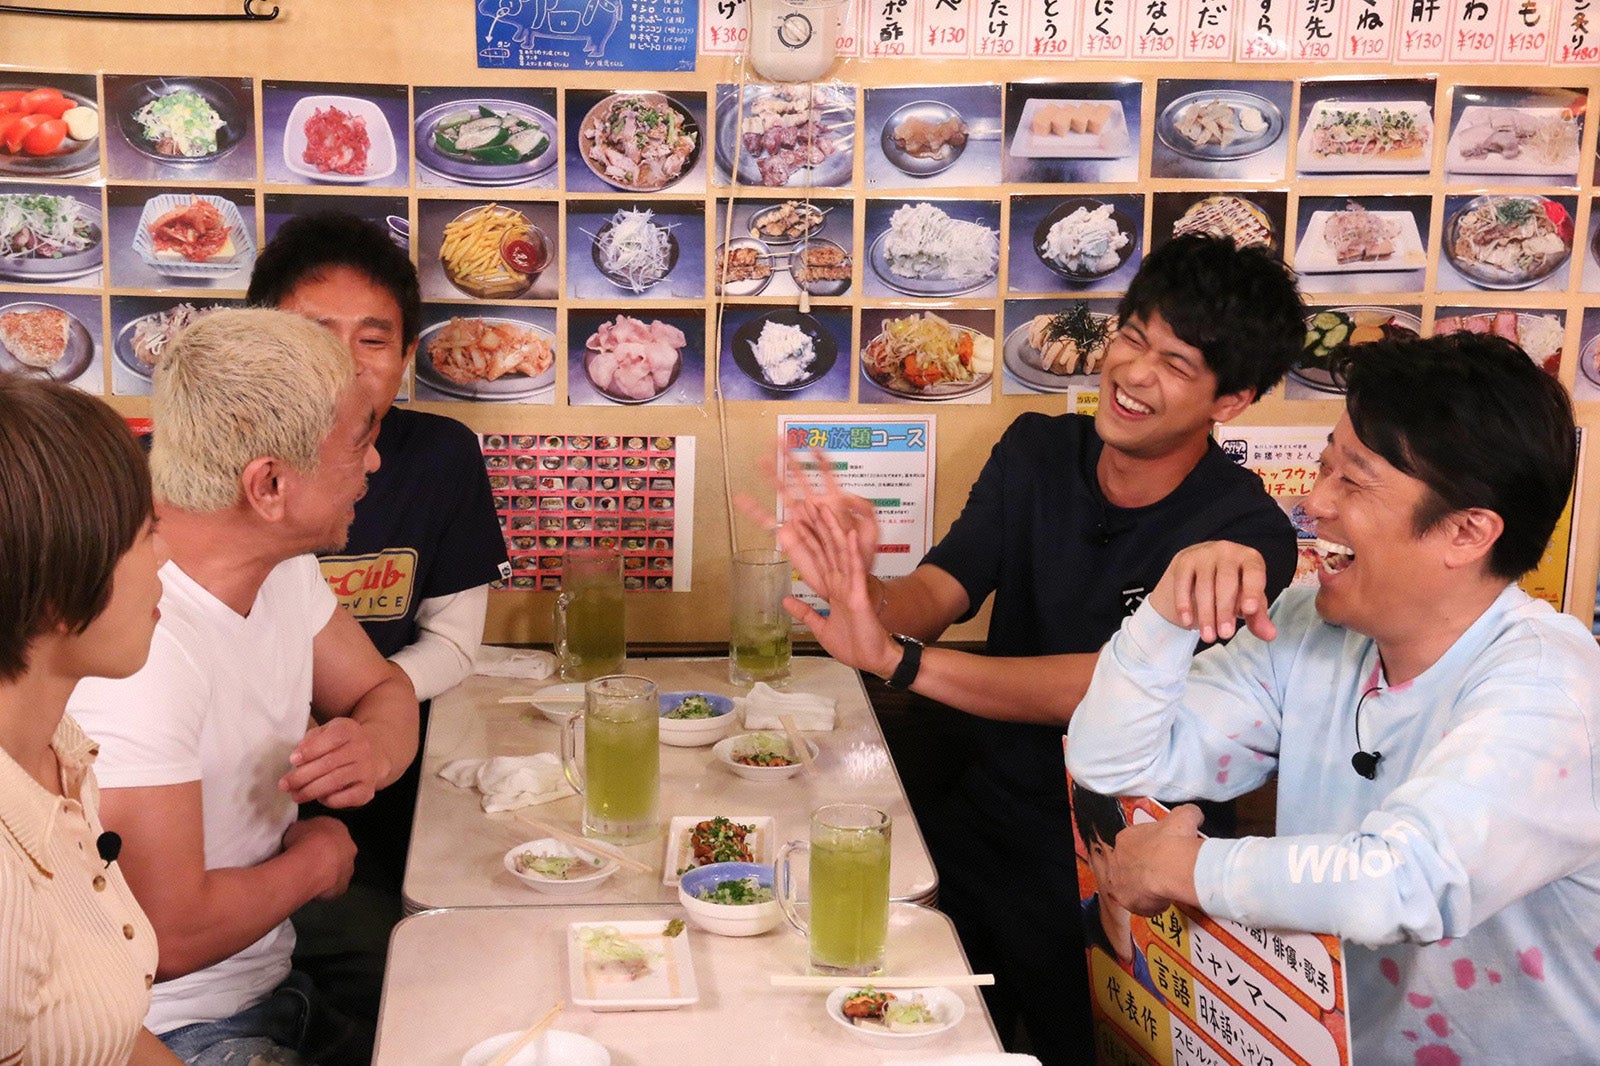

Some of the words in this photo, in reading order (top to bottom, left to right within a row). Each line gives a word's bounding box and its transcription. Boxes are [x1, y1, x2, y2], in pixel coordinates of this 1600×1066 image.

[1094, 0, 1114, 35] にく
[1145, 0, 1169, 36] なん
[1197, 0, 1228, 29] だ
[711, 27, 748, 46] ¥380
[929, 25, 966, 46] ¥130
[981, 36, 1014, 54] ¥130
[1034, 37, 1067, 55] ¥130
[1087, 34, 1122, 53] ¥130
[1139, 35, 1174, 54] ¥130
[1189, 30, 1226, 53] ¥130
[1350, 35, 1384, 56] ¥130
[1405, 30, 1442, 52] ¥130
[1457, 29, 1495, 51] ¥130
[1507, 33, 1545, 52] ¥130
[1298, 40, 1331, 57] ¥130
[787, 427, 926, 449] 飲み放題コース
[329, 559, 406, 597] Club
[1153, 956, 1191, 1008] 言語
[1194, 932, 1288, 1022] ミャンマー
[1106, 976, 1158, 1042] 代表作
